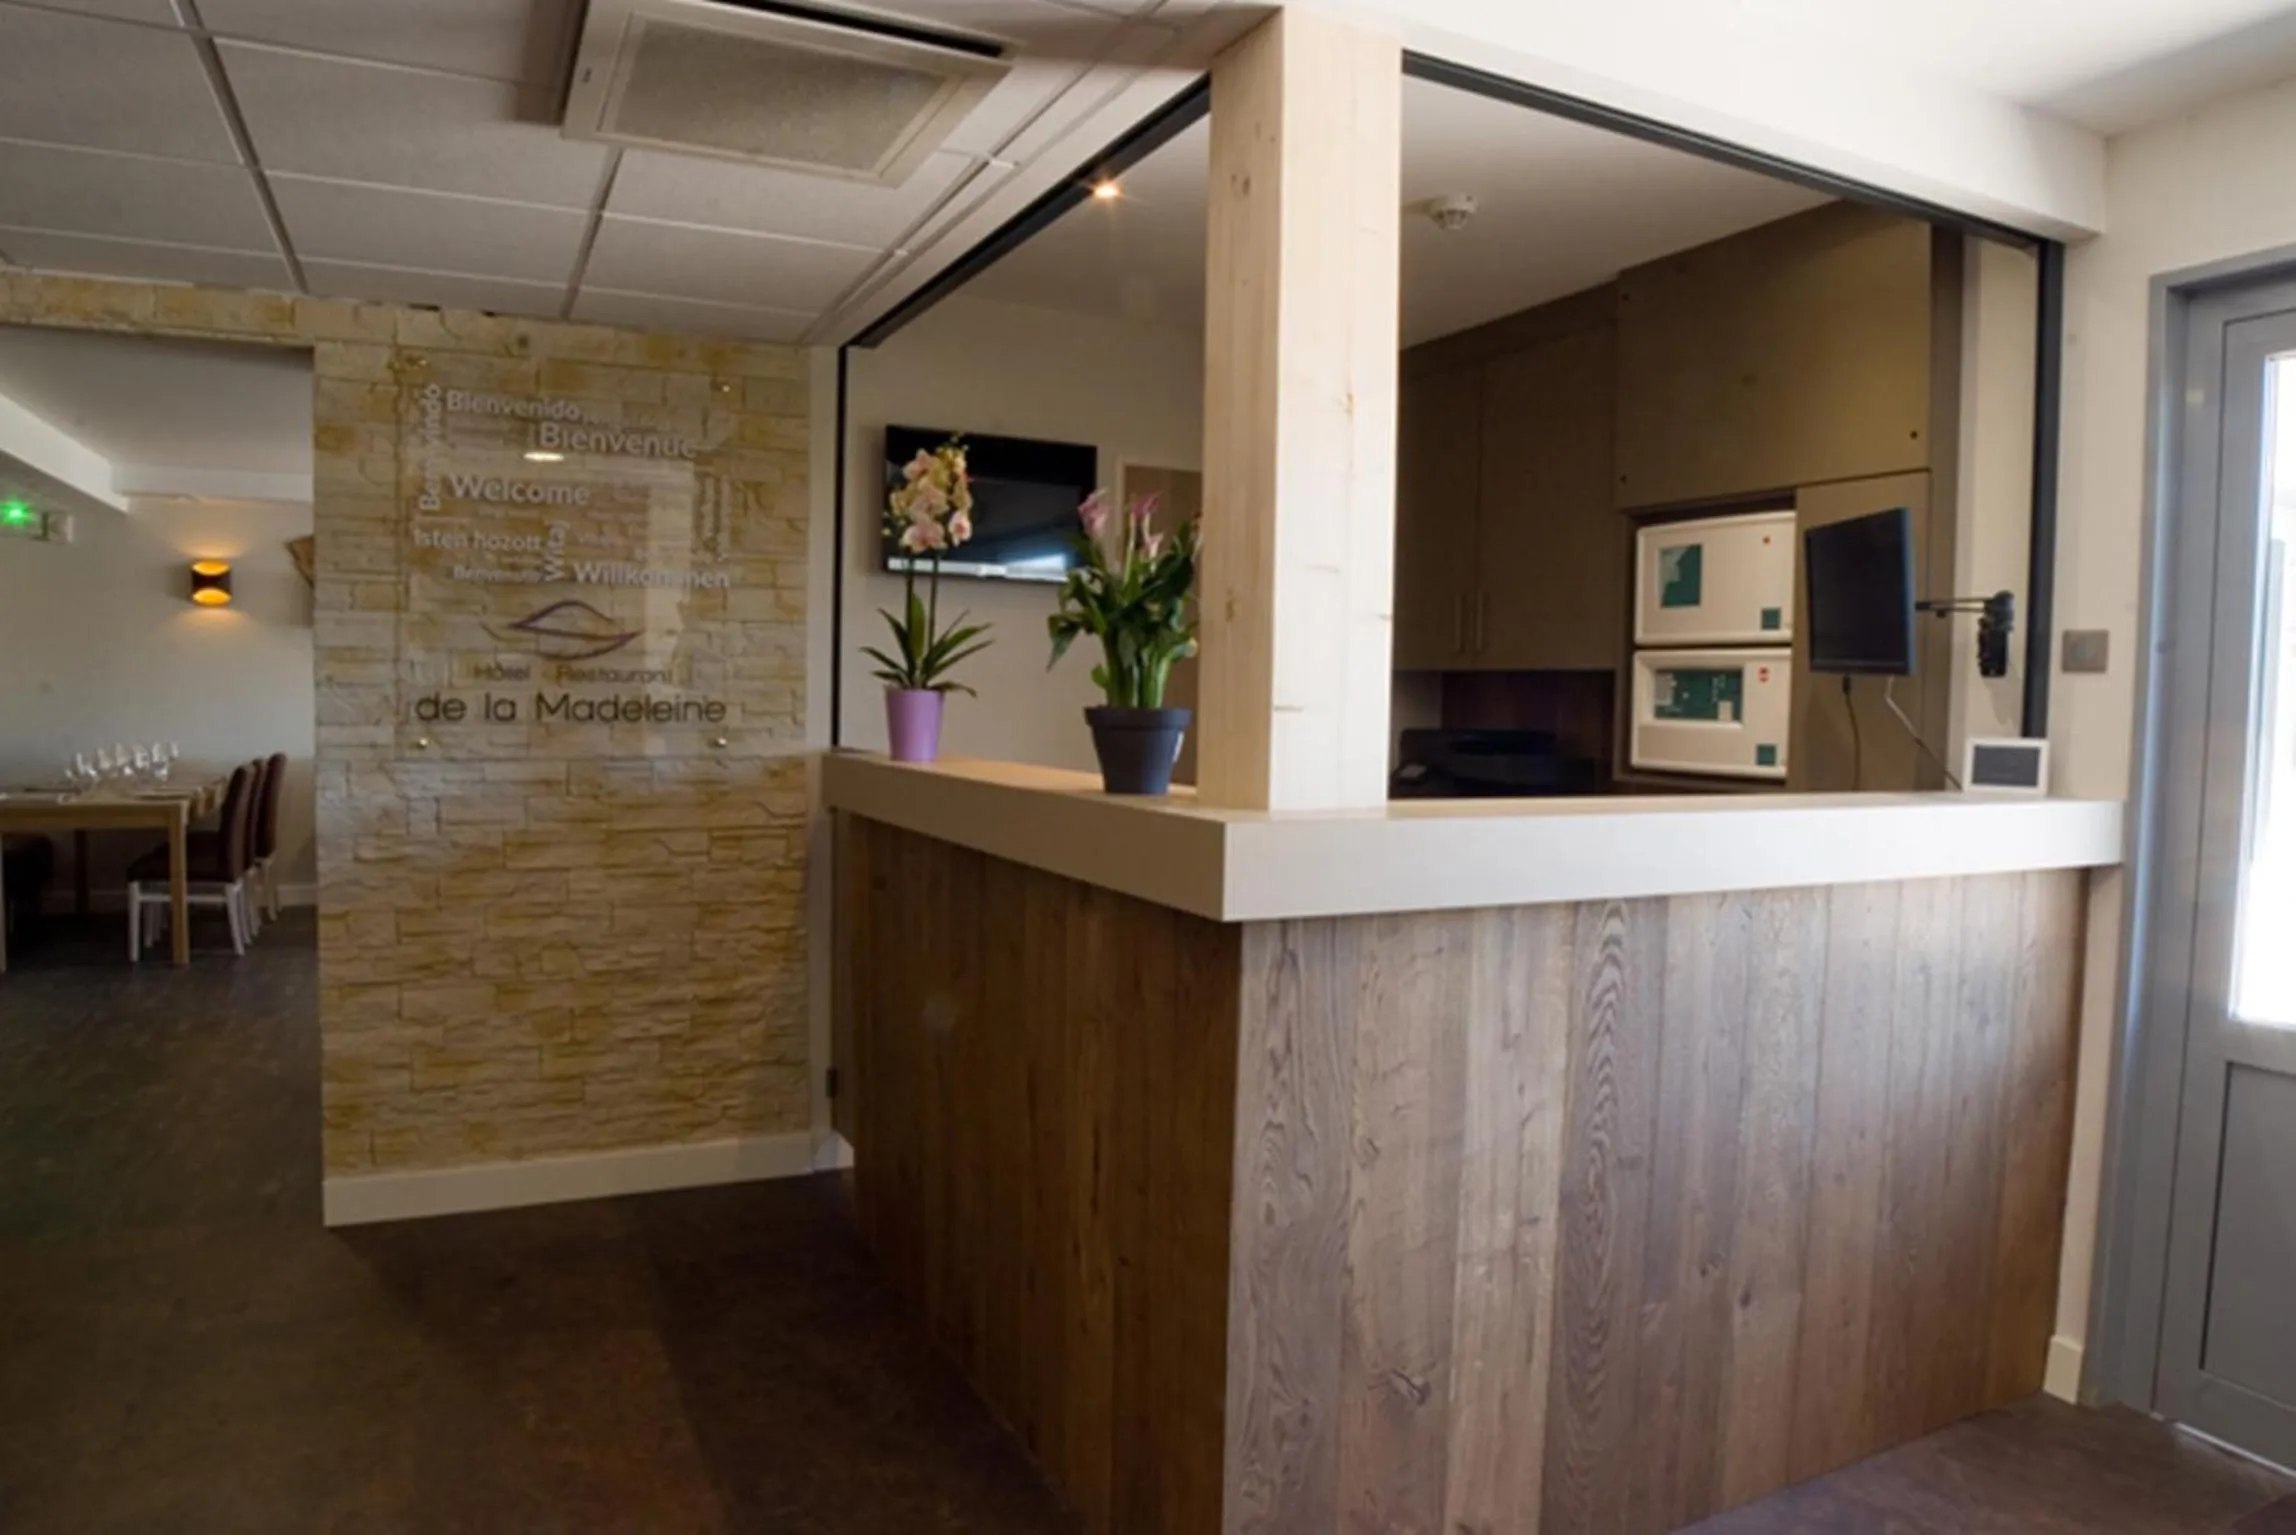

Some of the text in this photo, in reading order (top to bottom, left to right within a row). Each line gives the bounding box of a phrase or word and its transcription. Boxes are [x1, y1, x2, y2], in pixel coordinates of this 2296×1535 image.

[446, 389, 580, 422] Bienvenido
[539, 421, 698, 458] Bienvenue
[449, 474, 590, 505] Welcome
[572, 561, 730, 589] Willkommen
[415, 690, 727, 724] de la Madeleine
